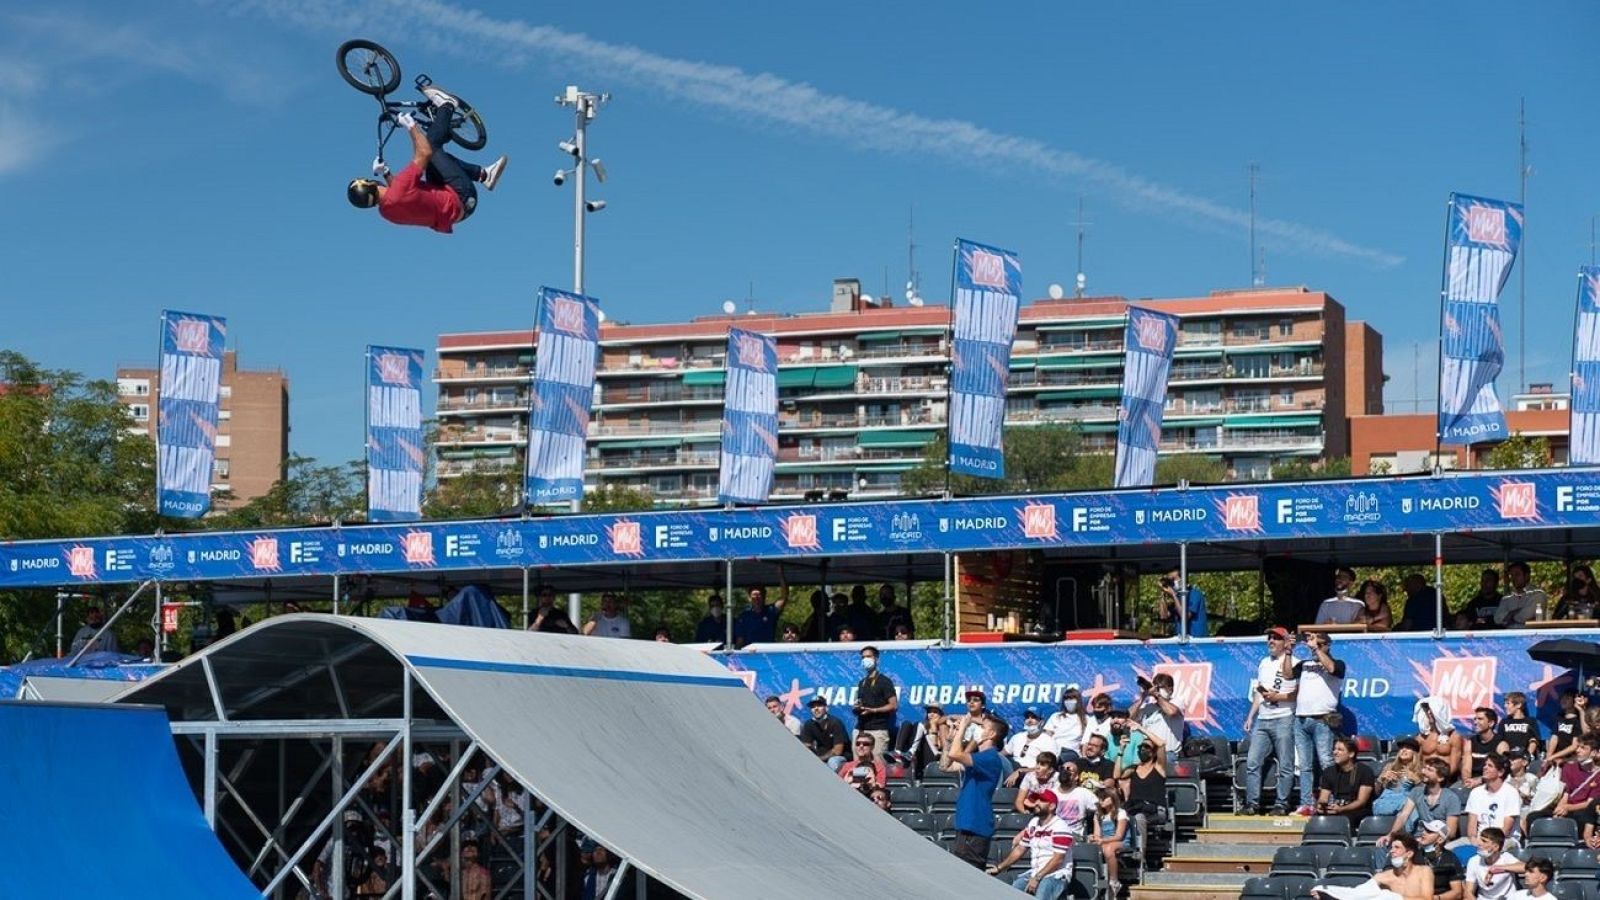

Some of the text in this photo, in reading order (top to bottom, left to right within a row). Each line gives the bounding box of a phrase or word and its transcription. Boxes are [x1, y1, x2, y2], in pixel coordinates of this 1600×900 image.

[1453, 422, 1500, 437] MADRID
[960, 457, 997, 470] MADRID
[536, 486, 577, 498] MADRID
[164, 500, 203, 512] MADRID
[1420, 496, 1480, 511] MADRID
[1152, 509, 1207, 523] MADRID
[955, 517, 1007, 530] MADRID
[724, 526, 772, 539] MADRID
[553, 534, 598, 546] MADRID
[201, 549, 241, 561] MADRID
[351, 543, 393, 555] MADRID
[22, 557, 60, 569] MADRID
